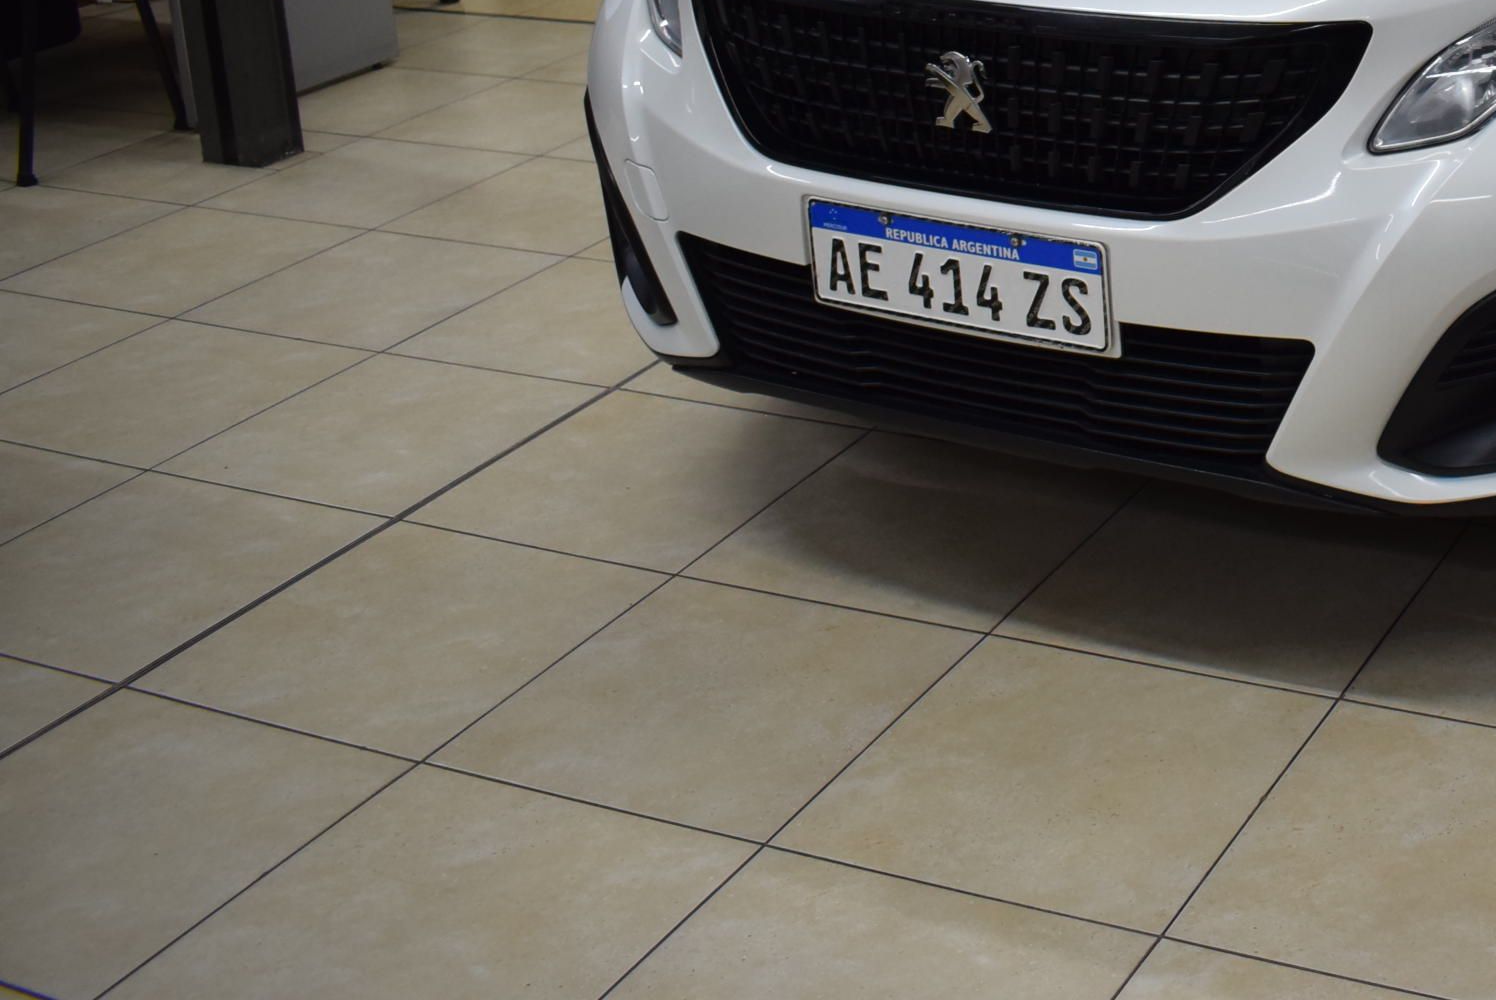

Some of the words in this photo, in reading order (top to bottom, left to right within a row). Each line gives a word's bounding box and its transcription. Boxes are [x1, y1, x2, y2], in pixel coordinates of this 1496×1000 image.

[885, 226, 949, 249] REPUBLICA
[951, 239, 1020, 261] ARGENTINA
[829, 237, 889, 301] AE
[908, 252, 1003, 322] 414
[1022, 271, 1092, 336] ZS
